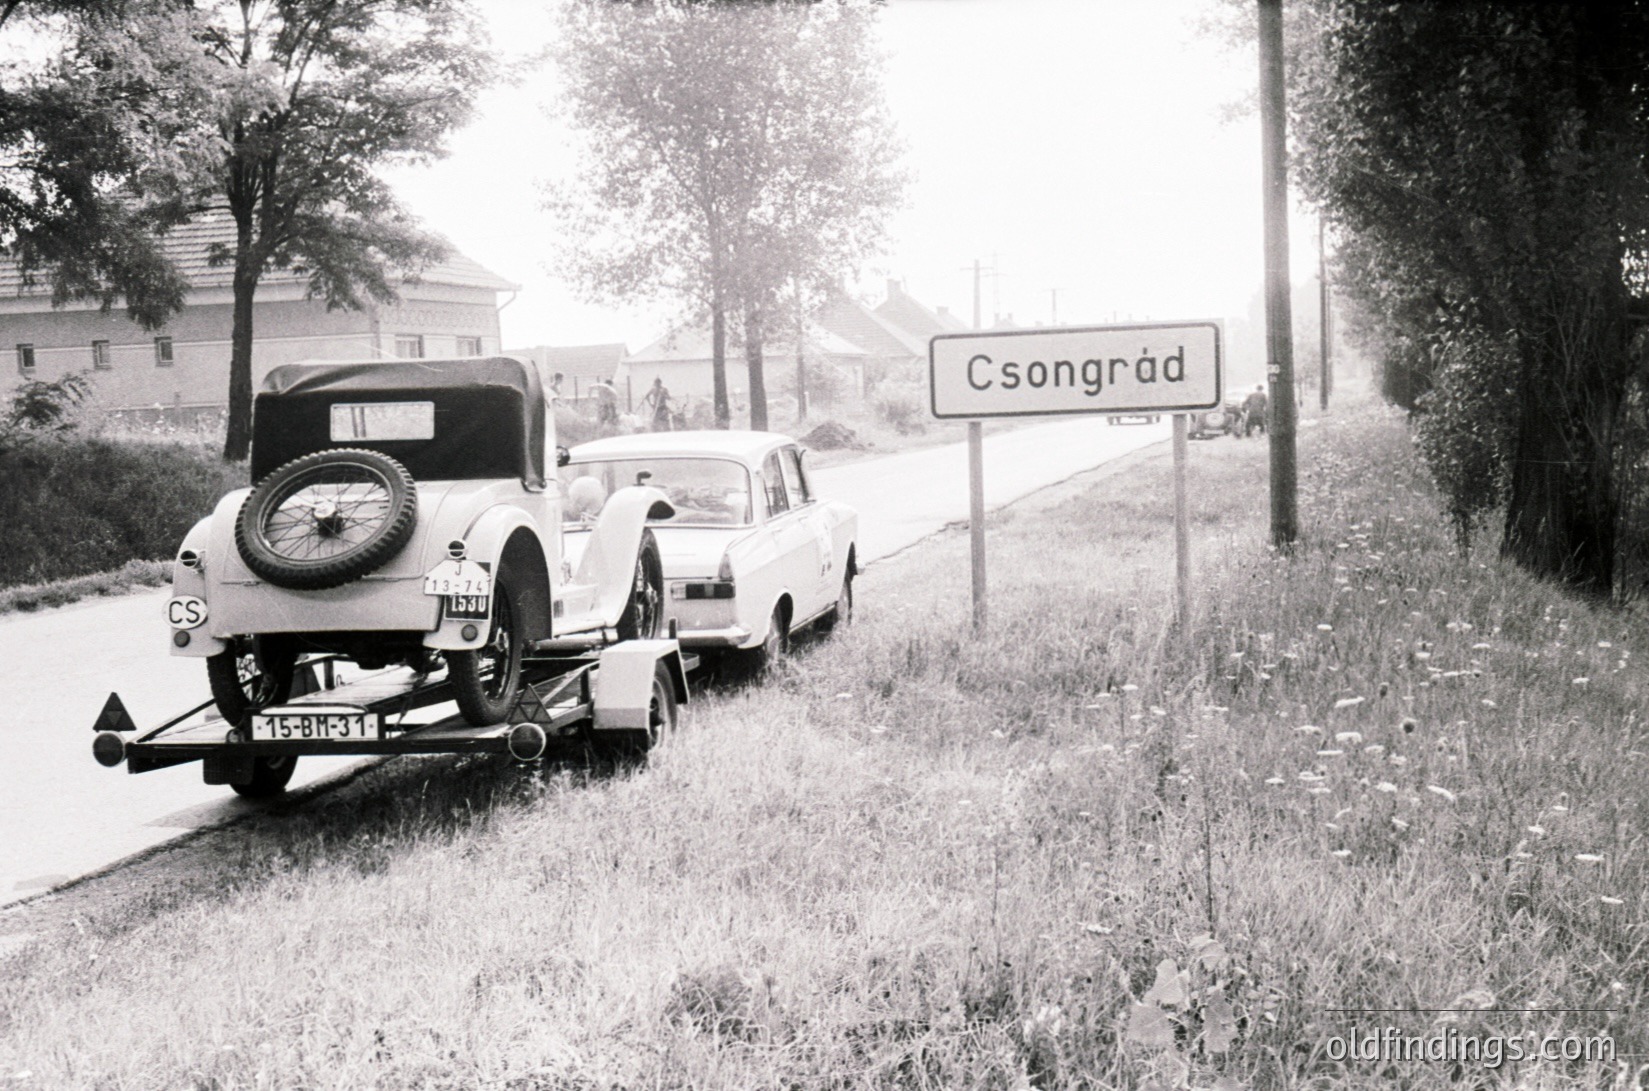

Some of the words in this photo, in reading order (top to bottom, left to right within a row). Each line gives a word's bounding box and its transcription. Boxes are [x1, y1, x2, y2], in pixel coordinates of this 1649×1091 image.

[967, 346, 1185, 396] Csongrád
[454, 562, 462, 576] J
[168, 600, 200, 624] CS
[265, 715, 365, 738] 15-BM-31
